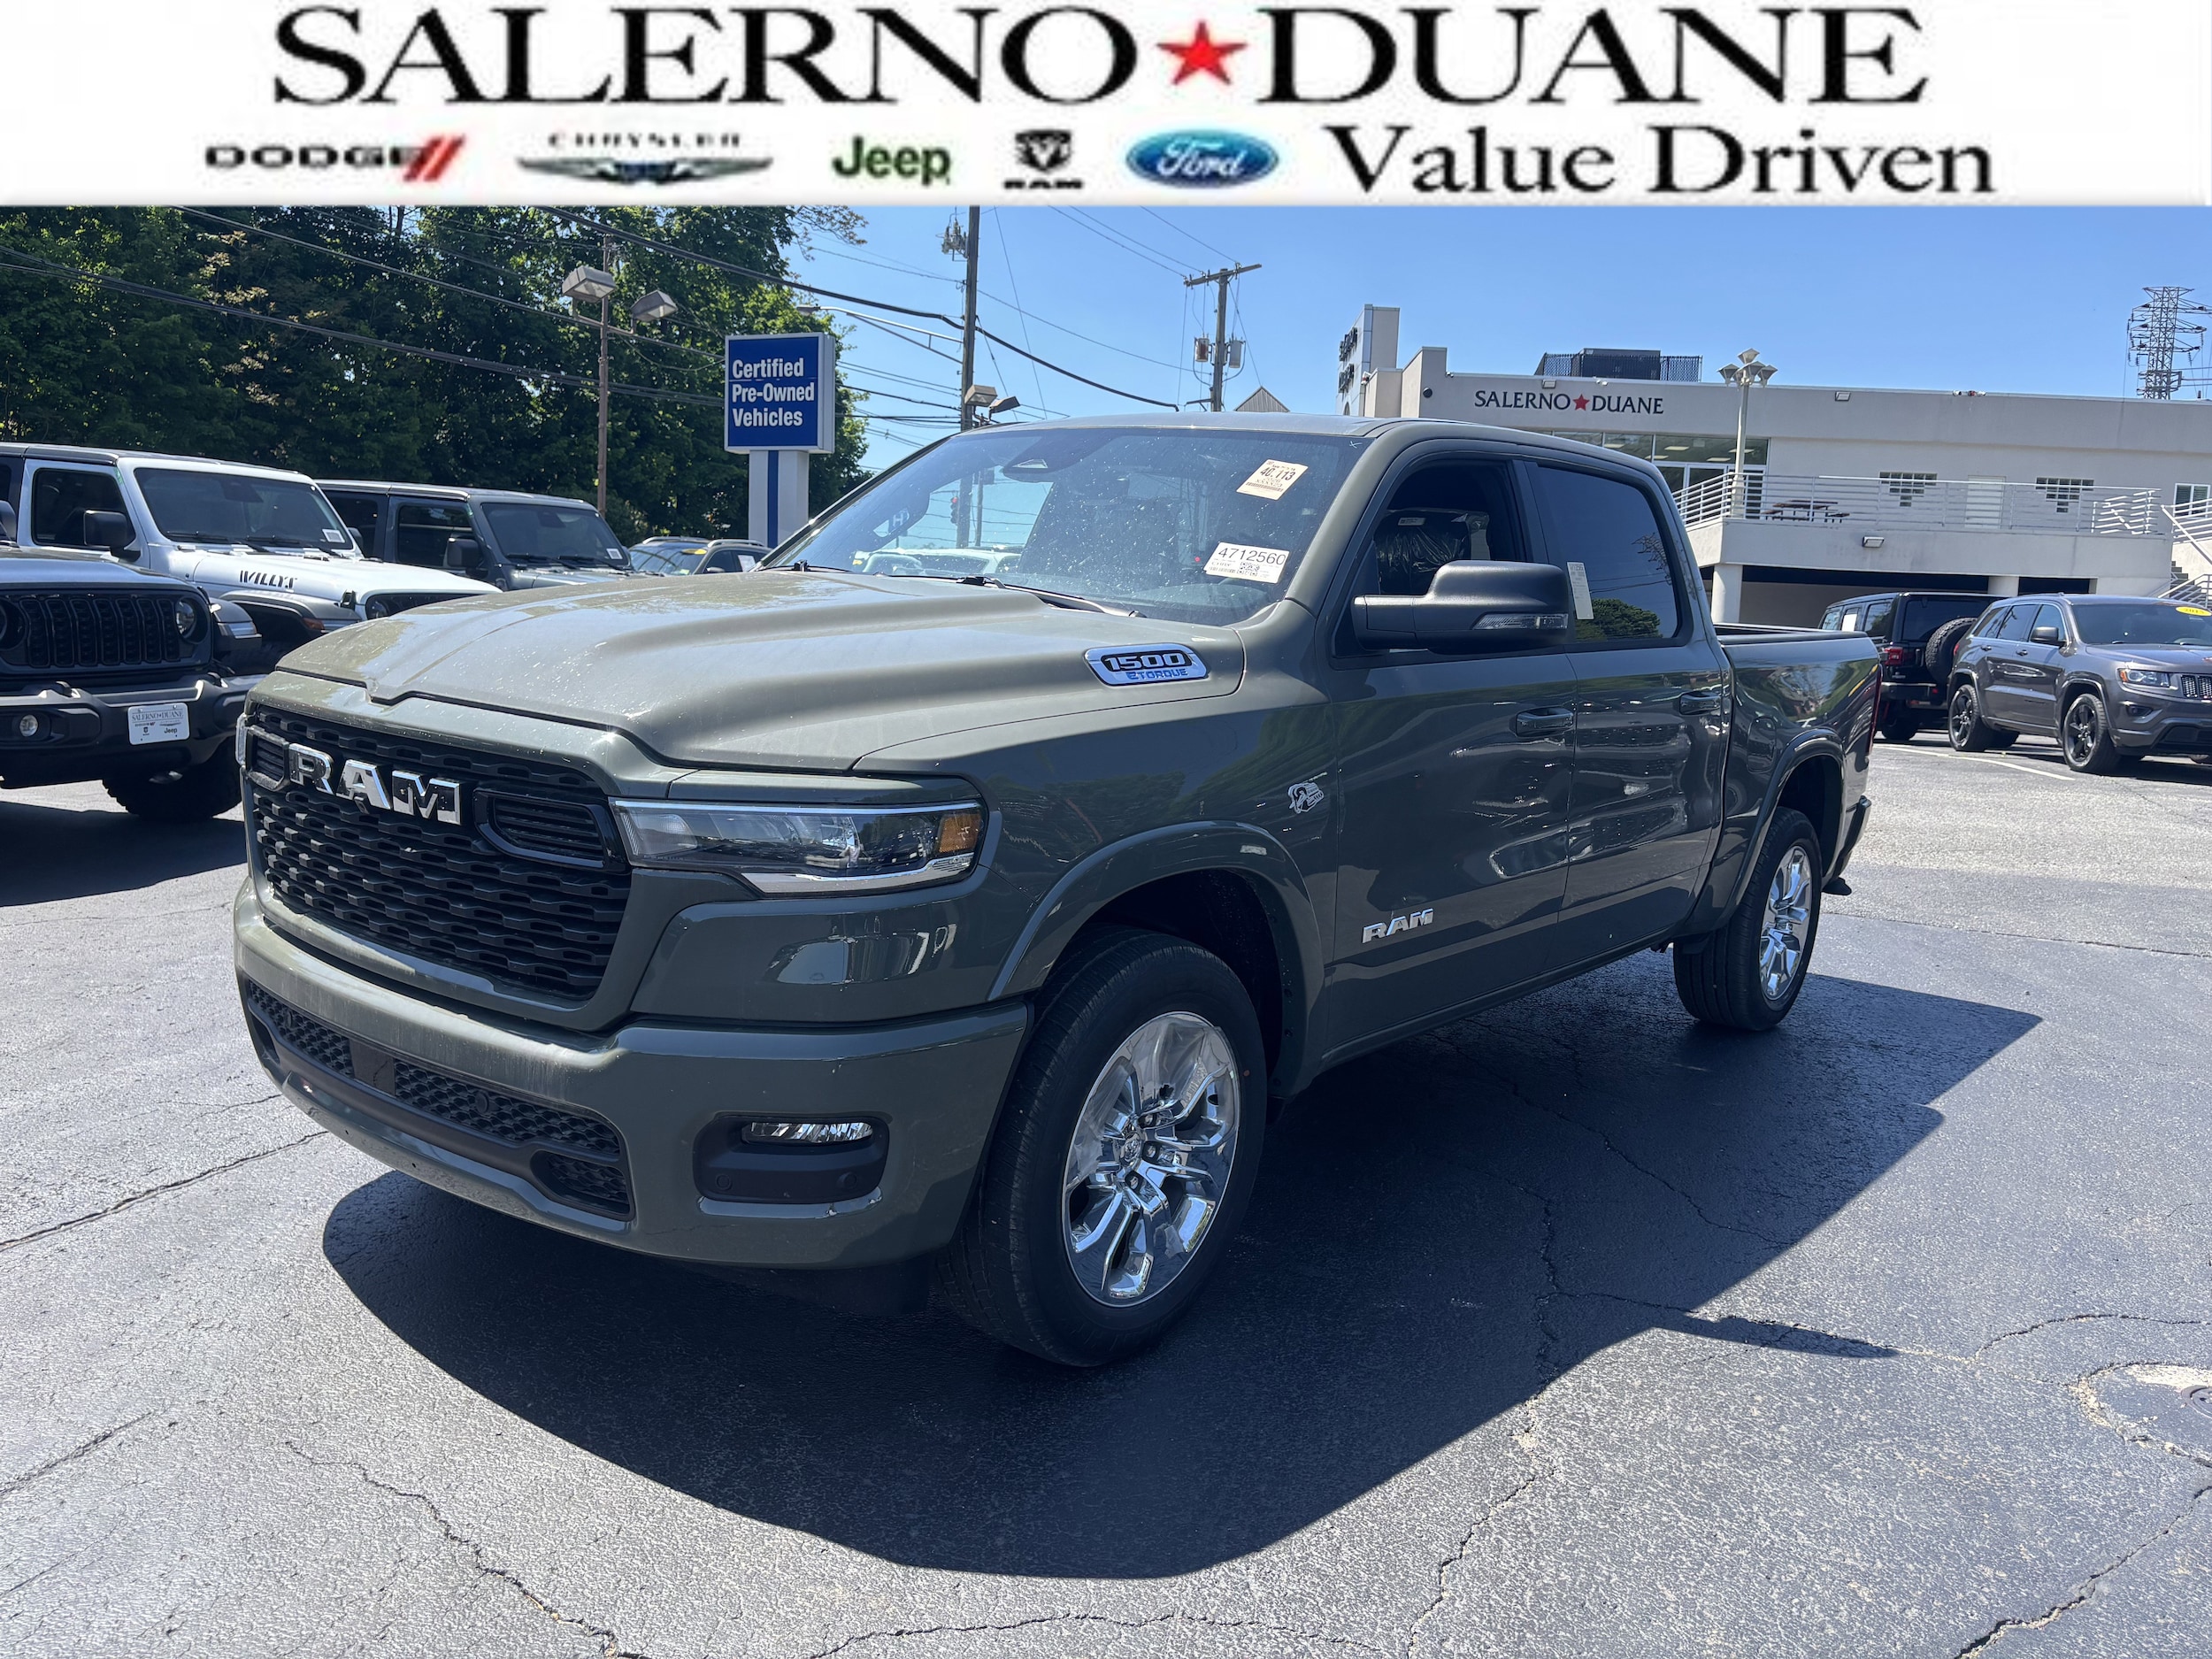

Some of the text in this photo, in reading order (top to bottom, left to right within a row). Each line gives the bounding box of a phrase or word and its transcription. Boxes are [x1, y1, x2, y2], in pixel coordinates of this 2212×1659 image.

[732, 357, 804, 379] Certified
[732, 382, 815, 403] Pre-Owned
[1474, 390, 1663, 414] SALERNO DUANE
[732, 408, 803, 426] Vehicles
[1218, 548, 1286, 565] 4712560
[240, 570, 297, 589] WILLYS
[1105, 653, 1186, 671] 1500
[288, 742, 461, 826] RAM
[1362, 908, 1433, 944] RAM
